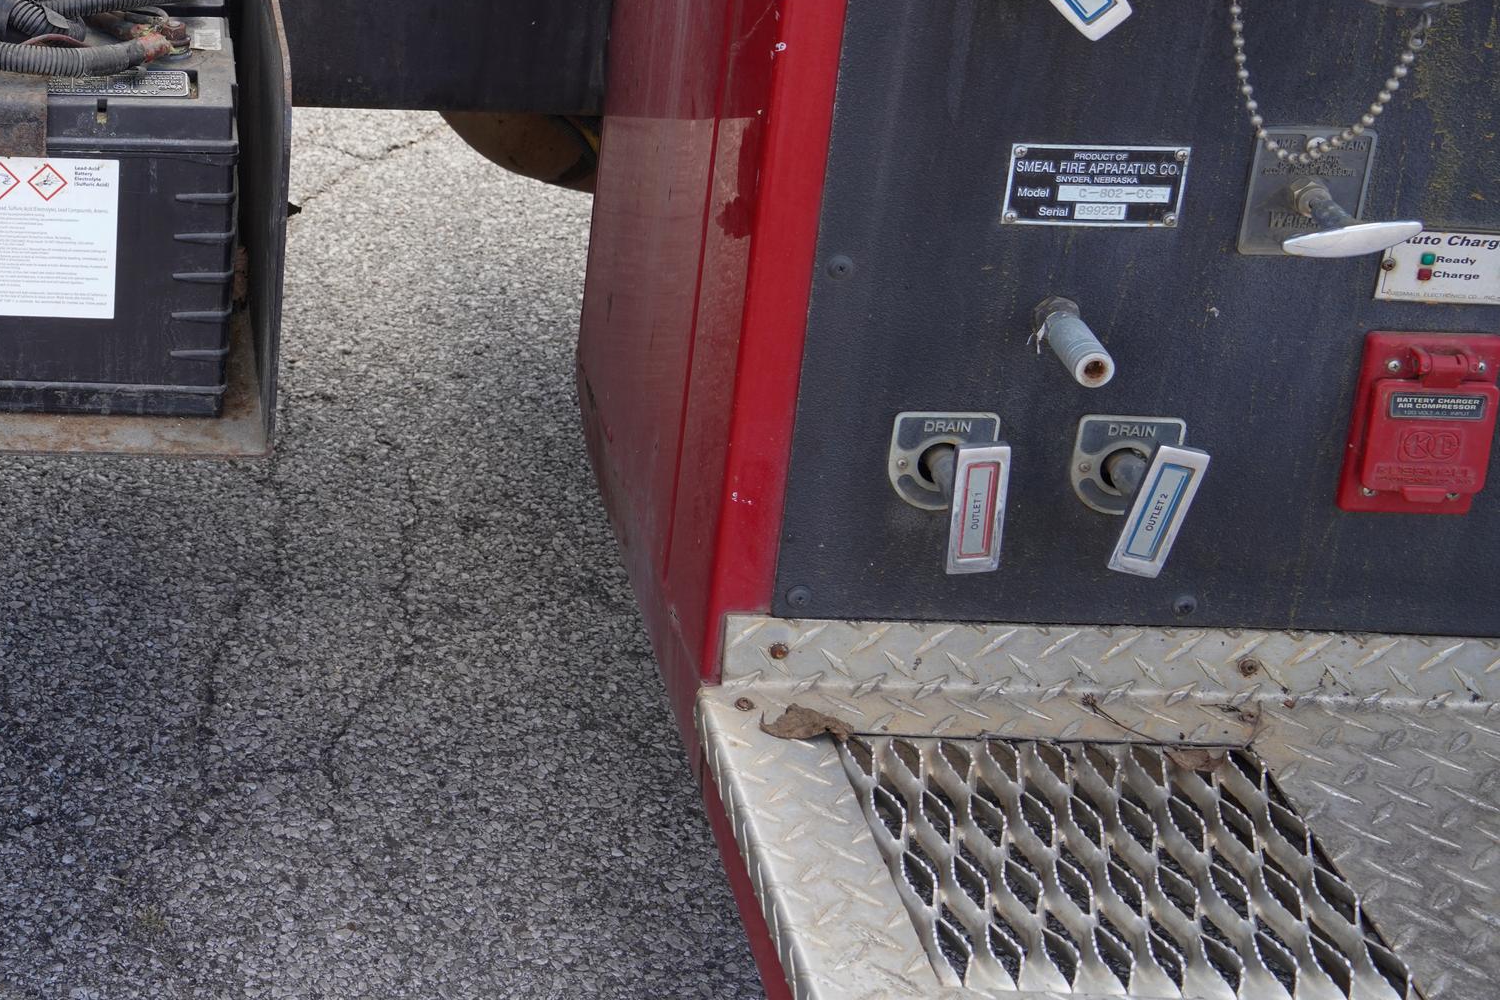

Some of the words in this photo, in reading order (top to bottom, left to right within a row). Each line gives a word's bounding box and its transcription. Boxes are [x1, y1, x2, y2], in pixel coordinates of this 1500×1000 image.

[1338, 140, 1368, 152] RAIN
[1073, 152, 1114, 161] PRODUCT
[1115, 153, 1129, 161] OF
[1016, 161, 1056, 174] SMEAL
[1059, 161, 1086, 174] FIRE
[1088, 162, 1157, 175] APPARATUS
[1159, 163, 1181, 176] CO.
[1055, 175, 1092, 184] SNYDER,
[1093, 176, 1139, 185] NEBRASKA
[1017, 186, 1050, 198] Model
[1038, 206, 1069, 217] Serial
[1077, 204, 1122, 216] 899221
[1447, 235, 1500, 250] Charg
[1435, 255, 1477, 266] Ready
[1432, 270, 1480, 281] Charge
[923, 421, 972, 433] DRAIN
[1107, 424, 1157, 437] DRAIN
[970, 500, 981, 530] OUTLET
[1145, 500, 1165, 532] OUTLET
[1160, 492, 1169, 500] 2
